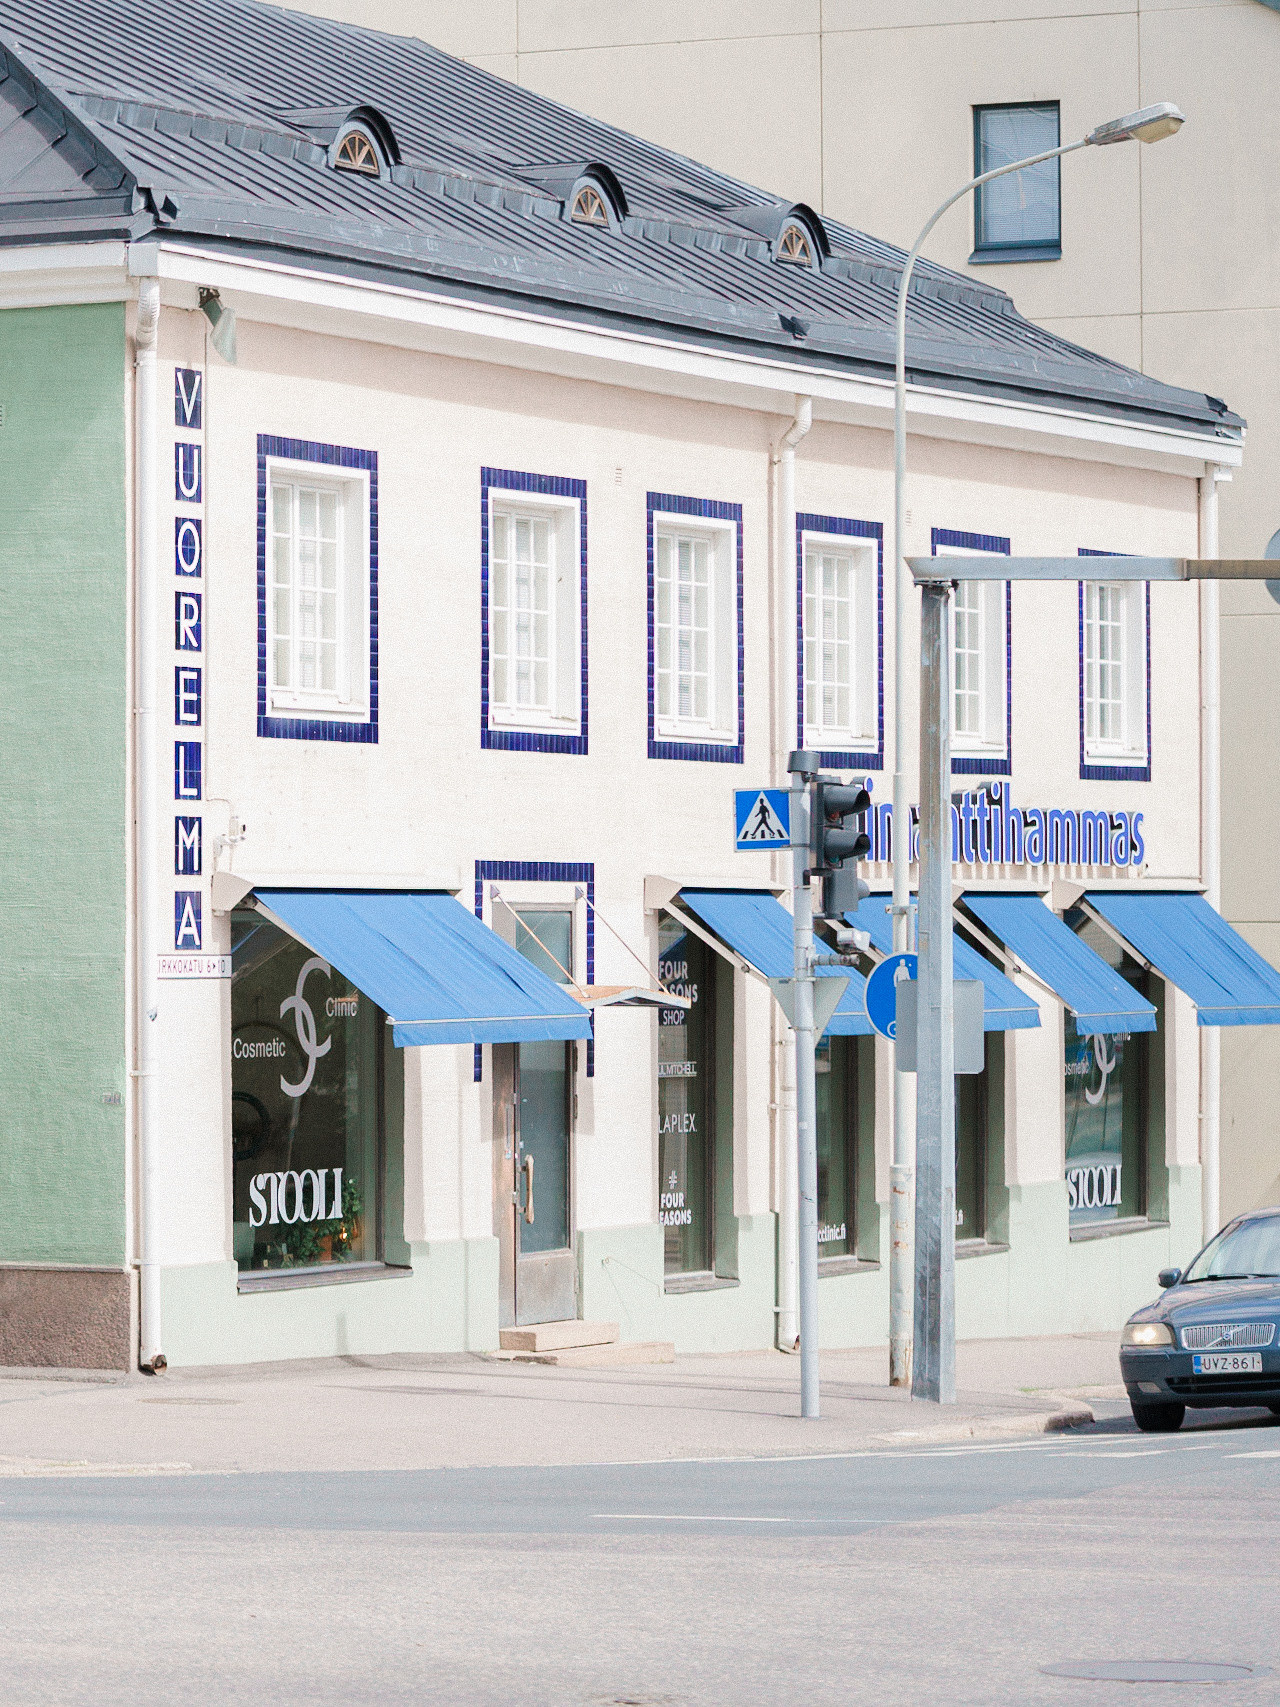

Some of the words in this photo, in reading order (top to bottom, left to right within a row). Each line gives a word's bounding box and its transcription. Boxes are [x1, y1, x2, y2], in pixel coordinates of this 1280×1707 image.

[176, 370, 201, 945] VUORELMA
[157, 959, 204, 973] IRKKOKATU
[659, 961, 689, 980] FOUR
[325, 997, 357, 1018] Clinic
[662, 1009, 685, 1026] SHOP
[233, 1037, 286, 1059] Cosmetic
[248, 1167, 344, 1228] STOOLI
[660, 1192, 685, 1209] FOUR
[660, 1208, 692, 1227] EASONS
[1203, 1356, 1256, 1371] UVZ-861
